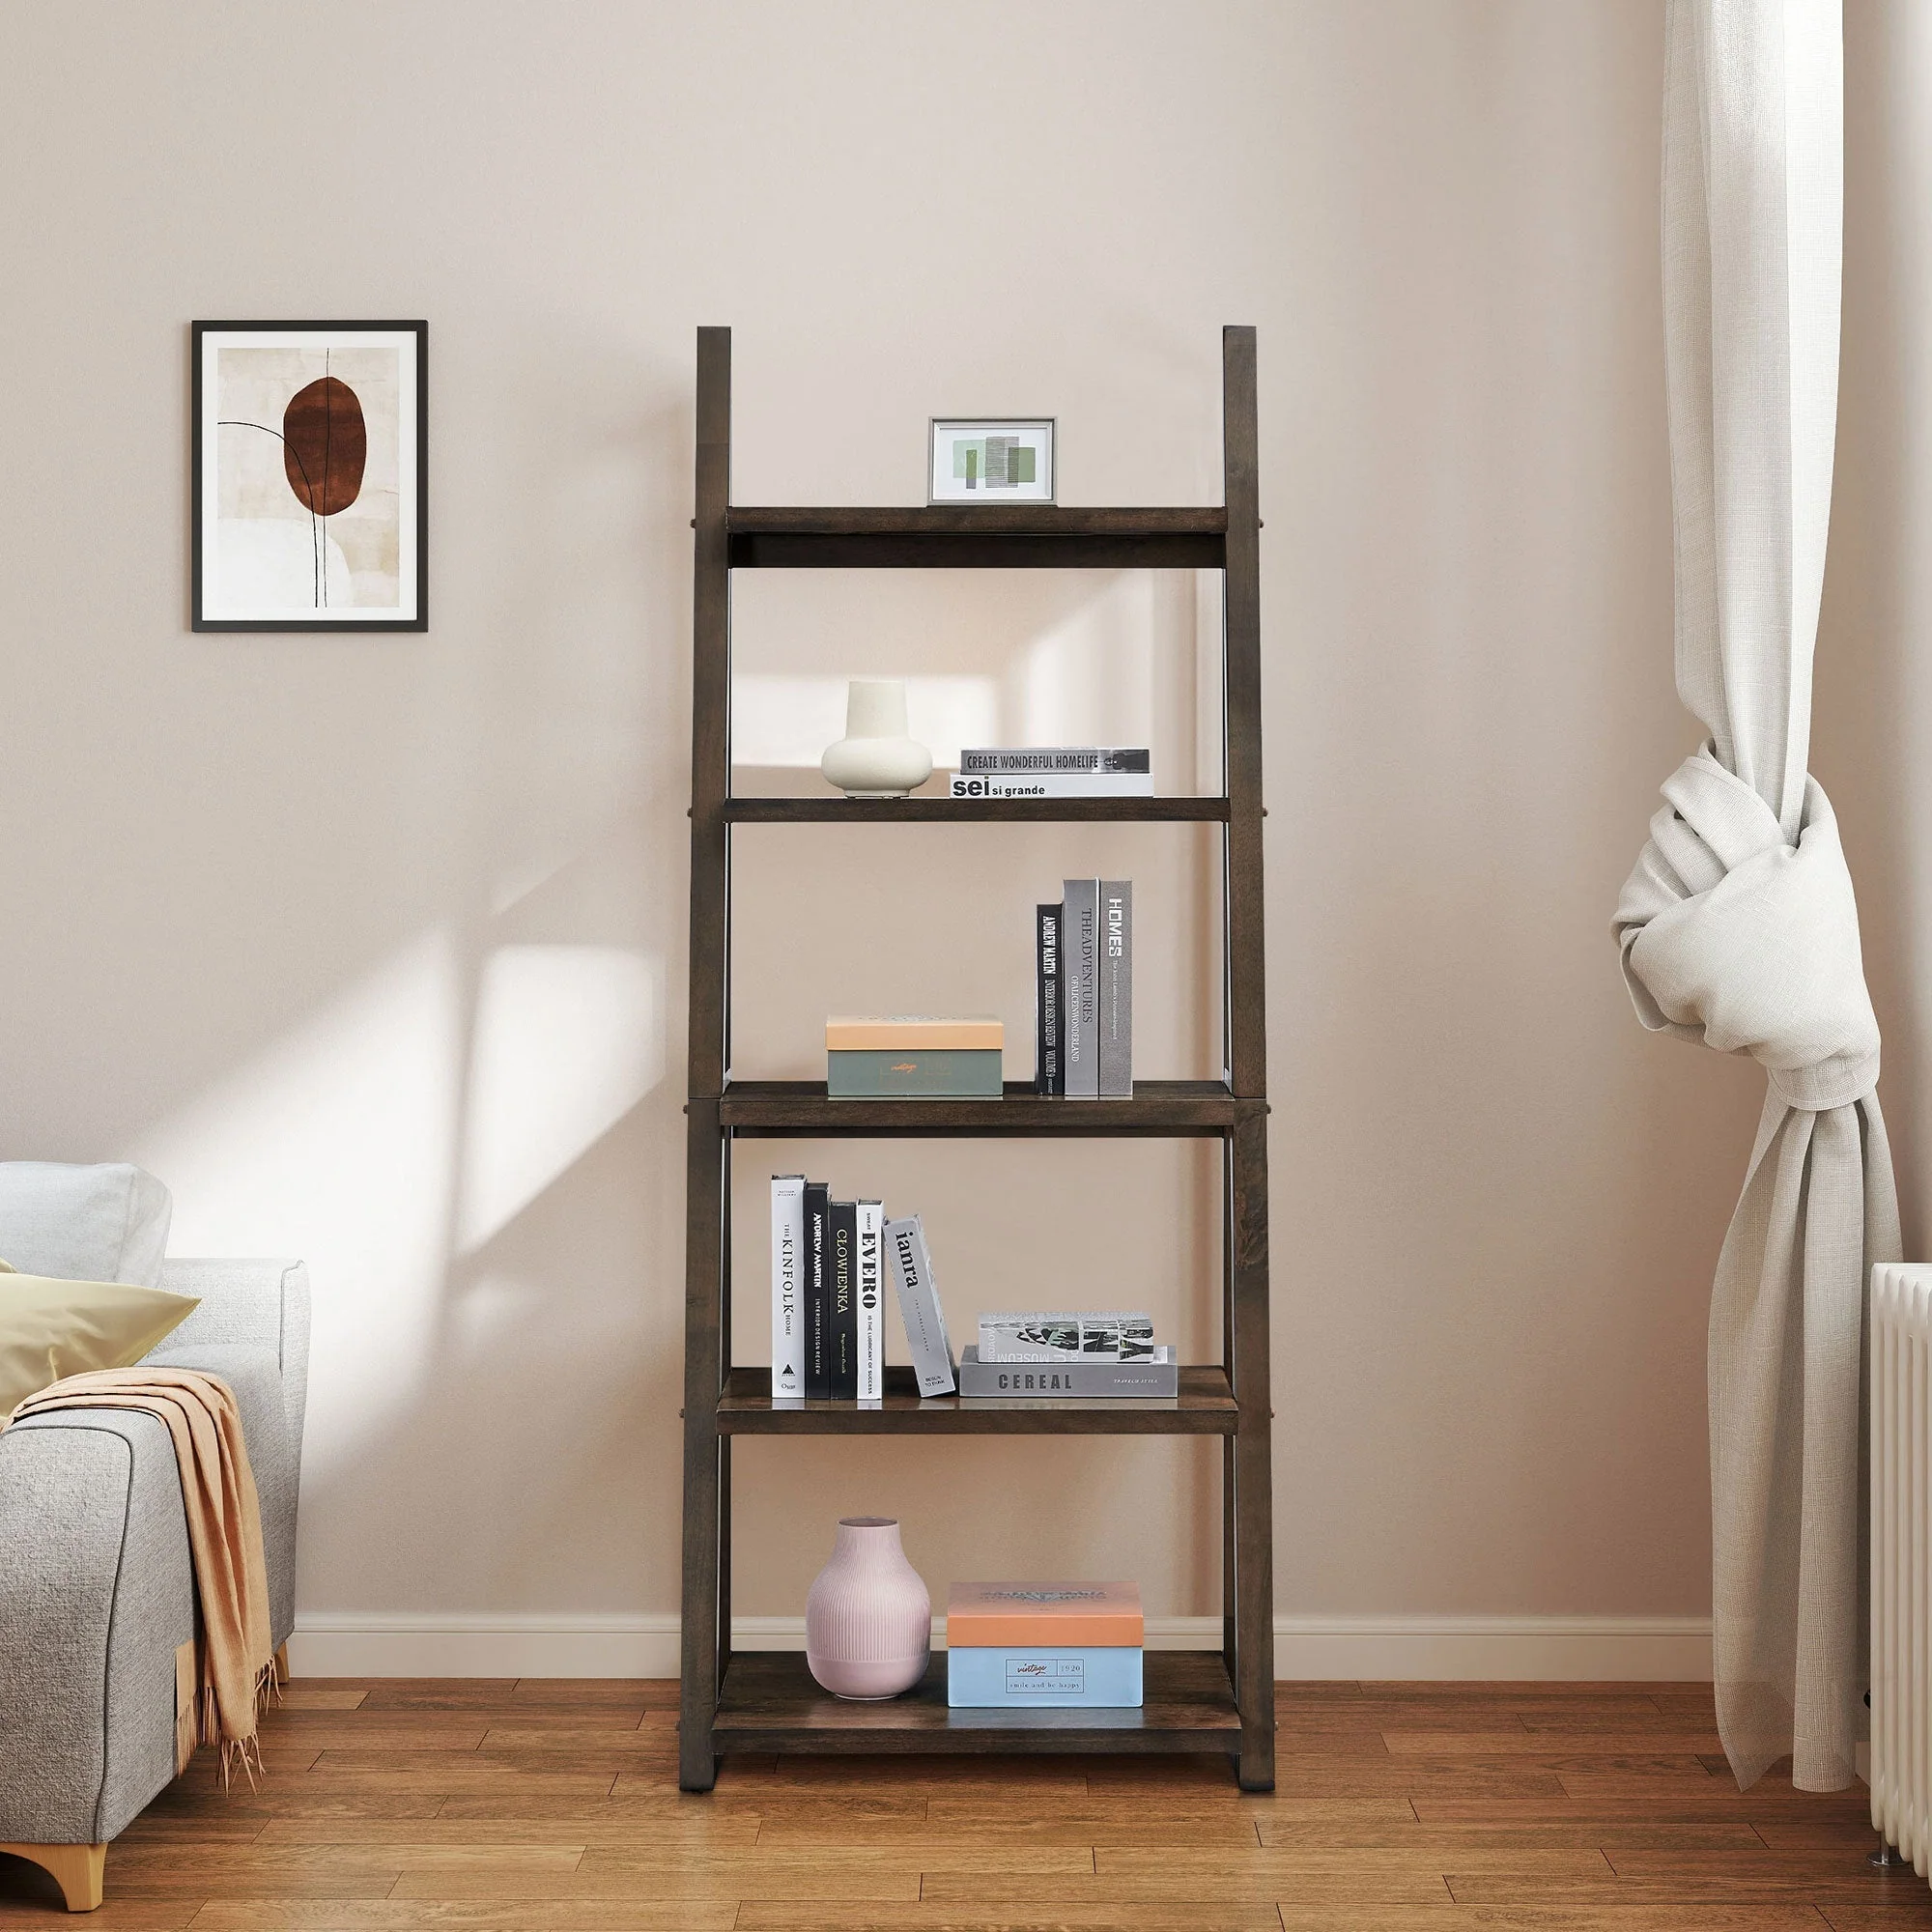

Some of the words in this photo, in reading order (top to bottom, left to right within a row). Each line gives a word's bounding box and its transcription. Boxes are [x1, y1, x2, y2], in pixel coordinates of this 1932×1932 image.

[967, 755, 998, 769] CREATE
[1001, 755, 1054, 769] WONDERFUL
[1056, 754, 1098, 769] HOMELIFE
[952, 776, 990, 797] sei
[992, 785, 1003, 796] si
[1005, 784, 1046, 798] grande
[1043, 915, 1056, 947] ANDREW
[1108, 898, 1122, 957] HOMES
[1043, 948, 1057, 975] MARTIN
[813, 1212, 822, 1253] ANDREW
[782, 1239, 794, 1314] KINFOLK
[813, 1253, 822, 1289] MARTIN
[863, 1233, 877, 1309] EVERO
[895, 1232, 919, 1289] ianra
[998, 1374, 1072, 1390] CEREAL
